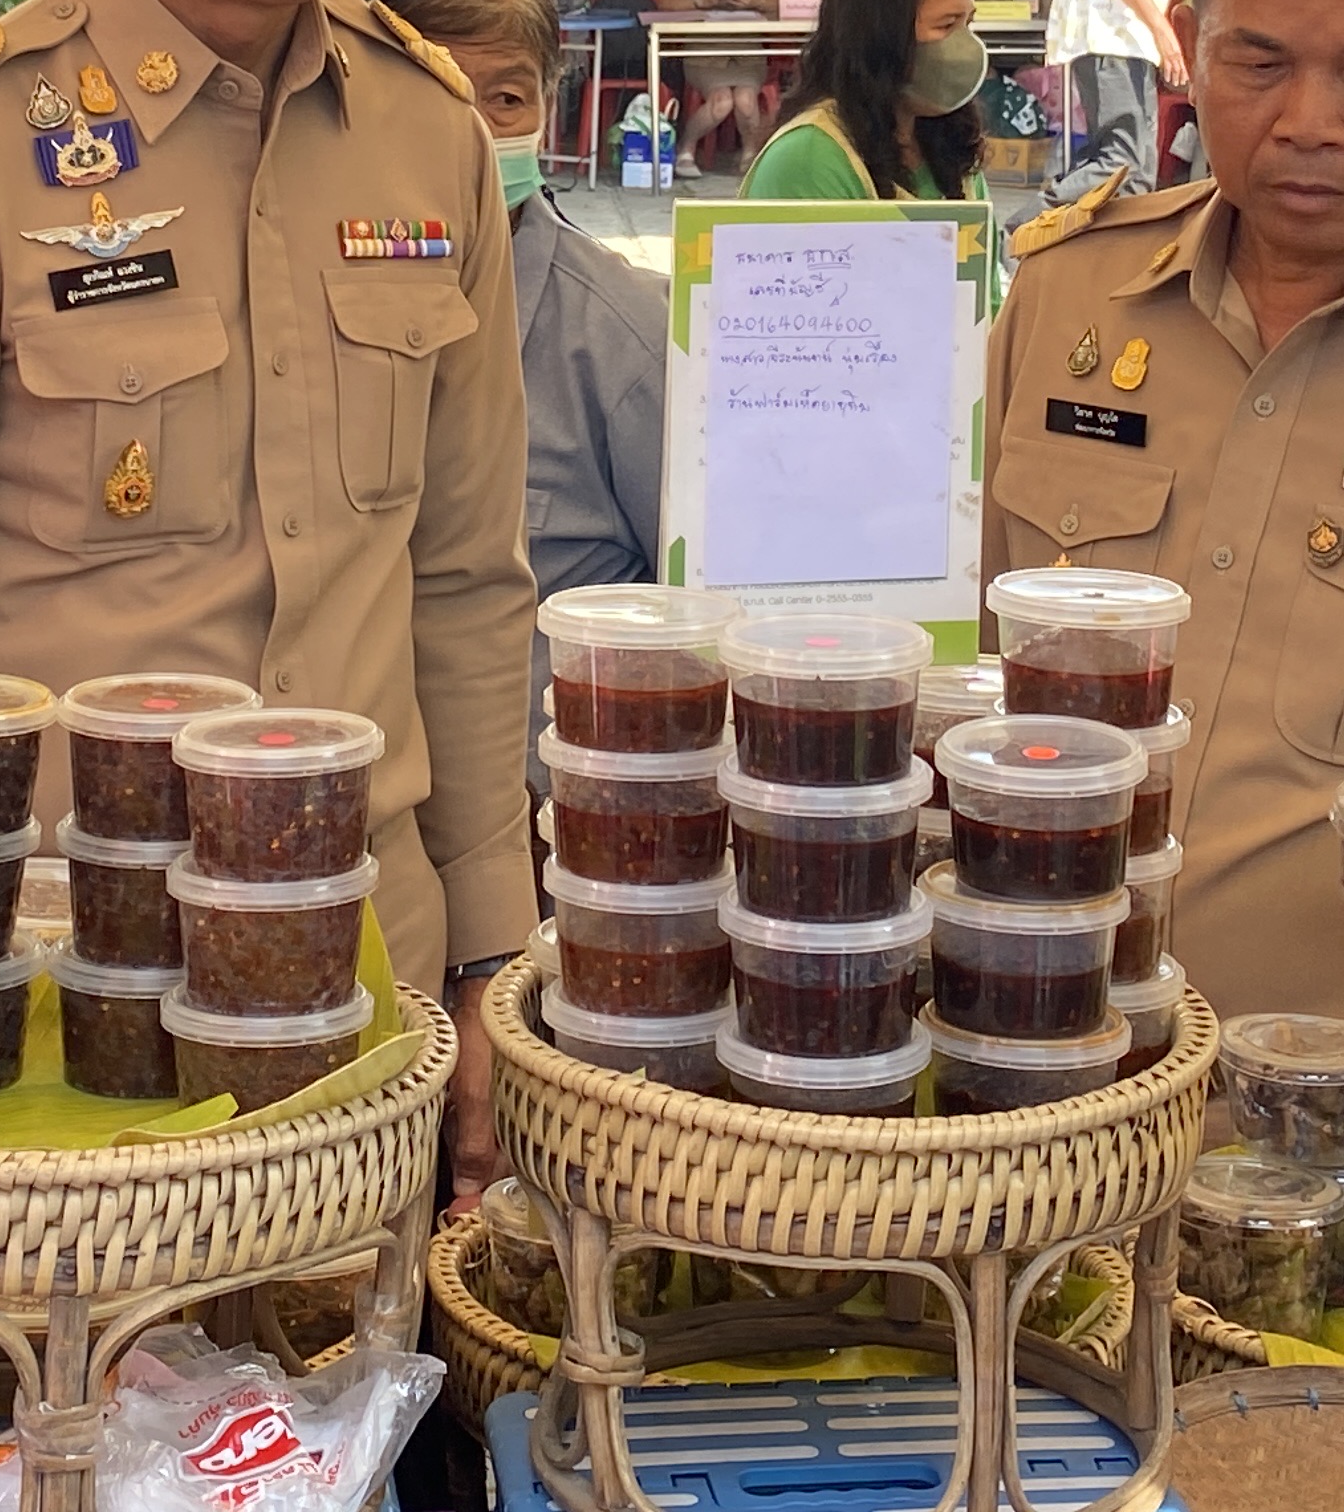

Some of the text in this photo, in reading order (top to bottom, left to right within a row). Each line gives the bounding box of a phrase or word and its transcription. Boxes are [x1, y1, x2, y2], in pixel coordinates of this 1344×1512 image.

[734, 251, 795, 265] ธนาคาร
[768, 596, 784, 606] Call
[786, 594, 813, 605] Center
